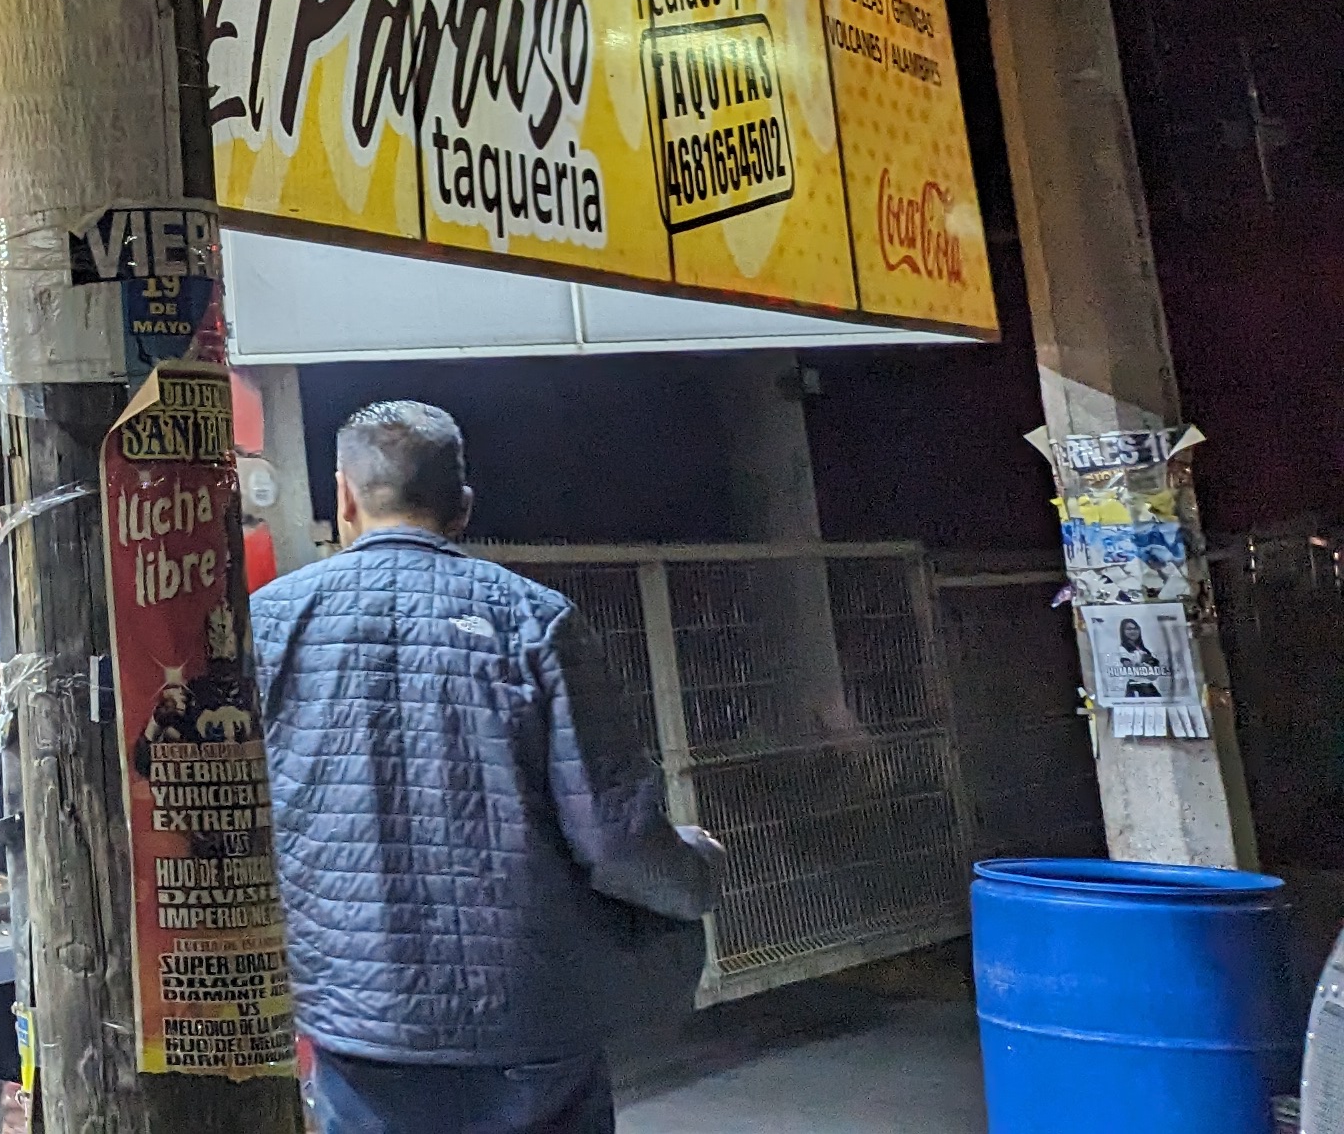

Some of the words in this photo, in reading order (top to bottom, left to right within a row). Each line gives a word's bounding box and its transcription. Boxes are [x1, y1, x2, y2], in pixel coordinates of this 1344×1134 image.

[651, 35, 773, 121] TAQUIZAS
[432, 115, 604, 239] taqueria
[666, 116, 787, 207] 4681654502
[133, 320, 193, 335] MAYO
[149, 302, 178, 316] DE
[117, 470, 213, 547] lucha
[134, 538, 217, 608] libre
[158, 907, 249, 929] IMPERIO
[159, 954, 230, 976] SUPER
